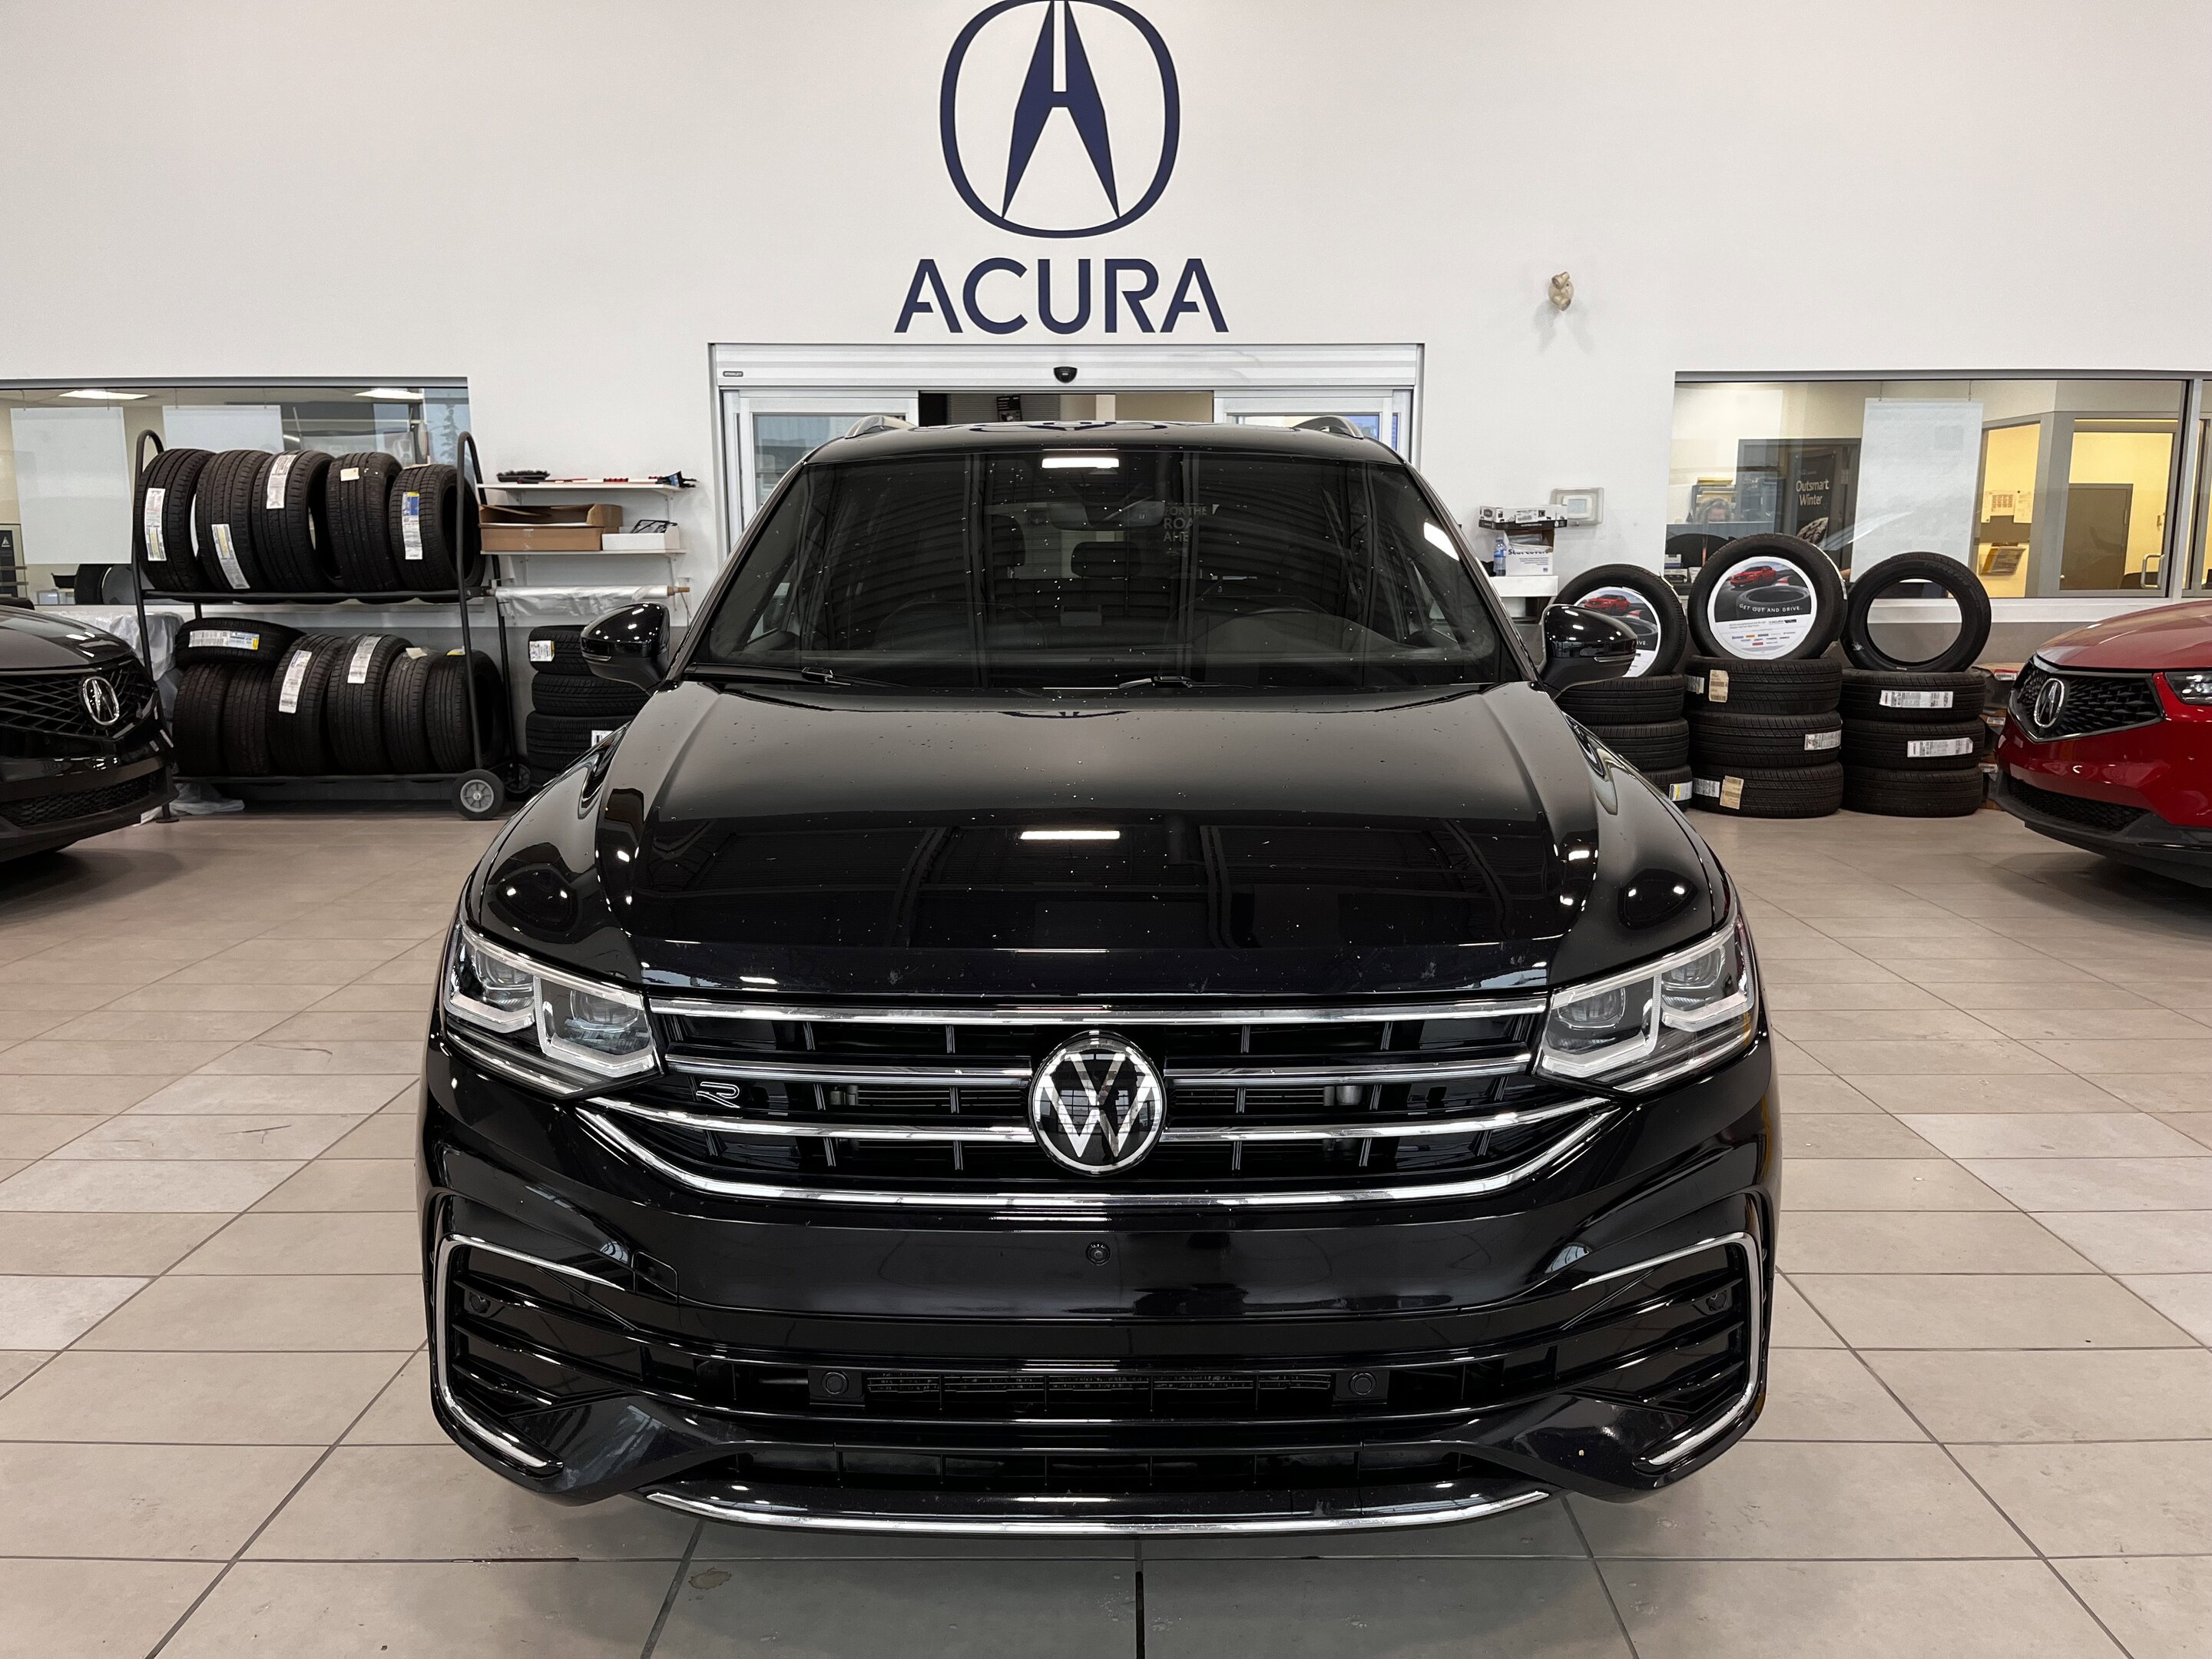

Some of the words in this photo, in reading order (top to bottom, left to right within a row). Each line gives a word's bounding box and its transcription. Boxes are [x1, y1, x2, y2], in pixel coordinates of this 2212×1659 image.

[894, 257, 1229, 334] ACURA
[1796, 478, 1830, 492] Outsmart
[1799, 494, 1823, 506] Winter
[1163, 518, 1194, 529] ROA
[696, 1081, 740, 1108] R
